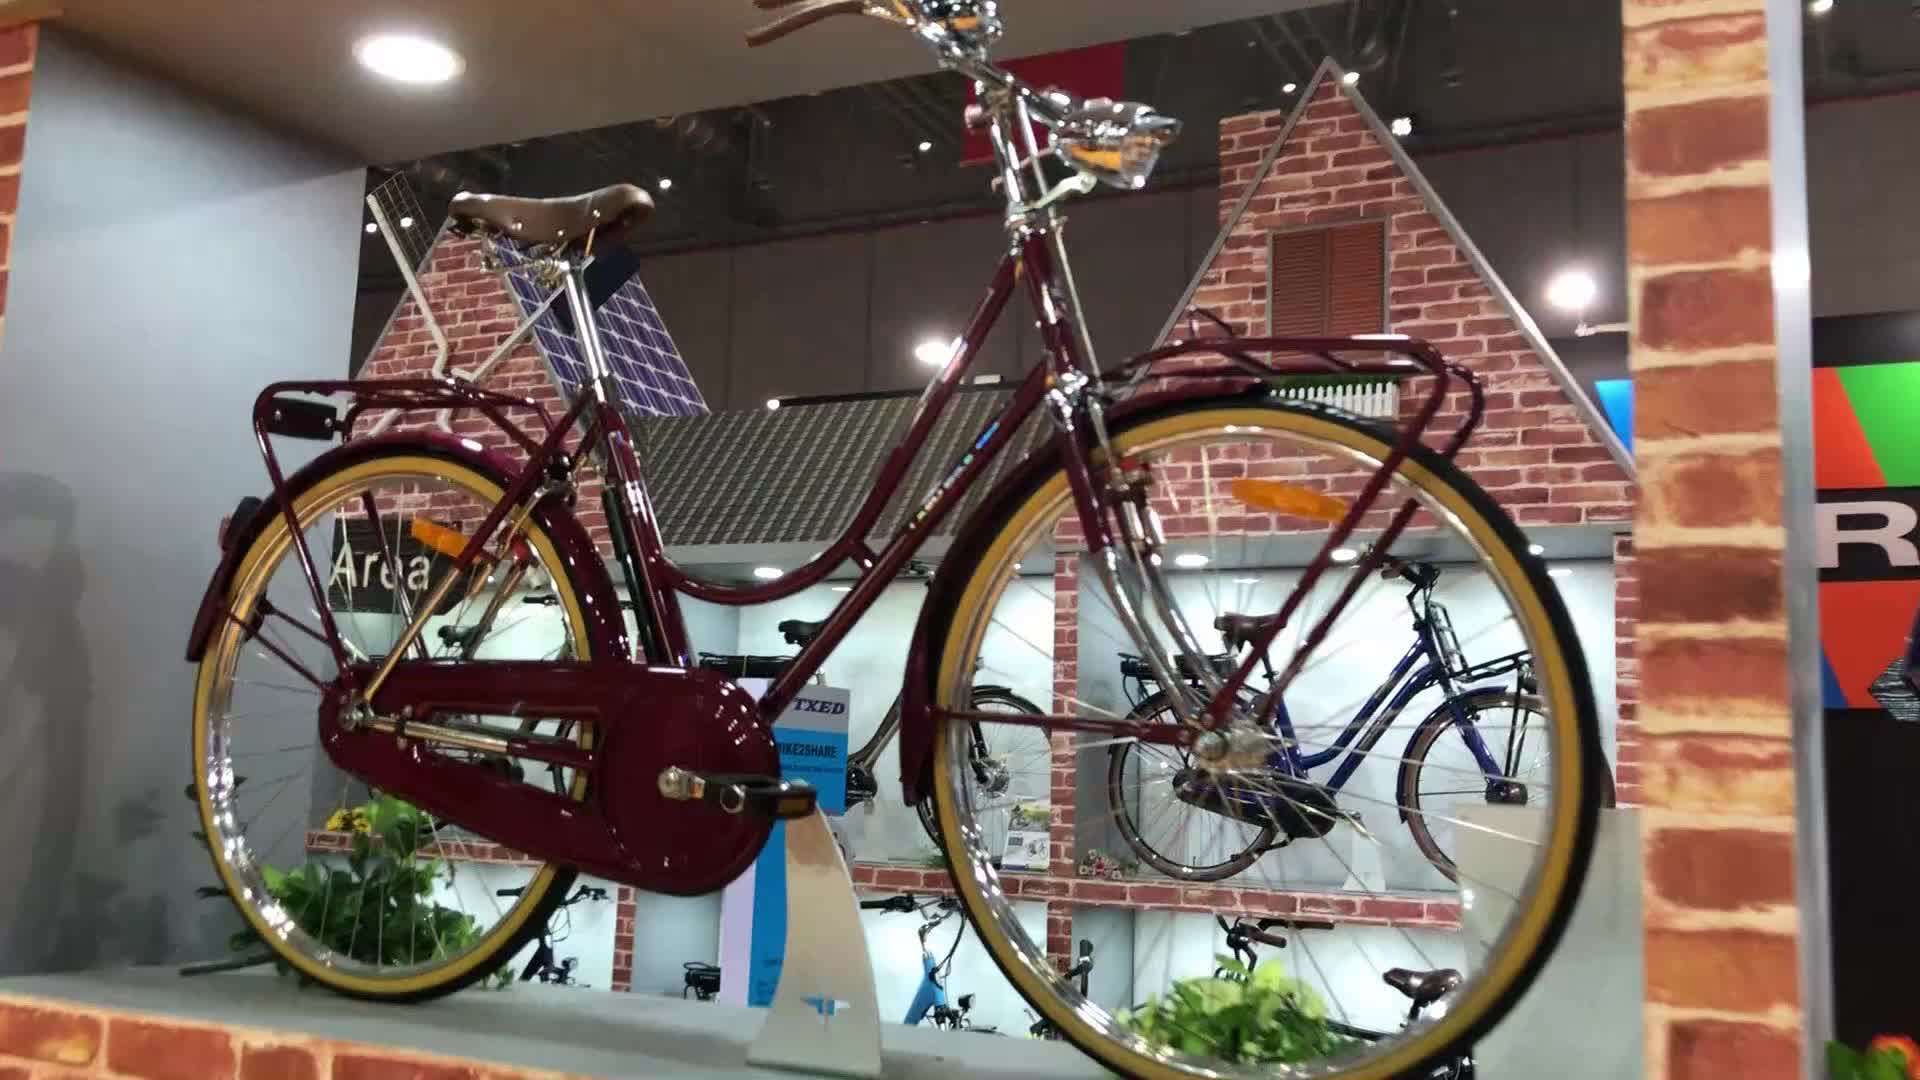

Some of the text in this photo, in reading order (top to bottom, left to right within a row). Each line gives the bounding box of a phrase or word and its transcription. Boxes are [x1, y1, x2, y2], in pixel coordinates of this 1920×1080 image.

[1815, 501, 1920, 568] R
[328, 541, 430, 591] Area
[793, 697, 845, 715] TXED
